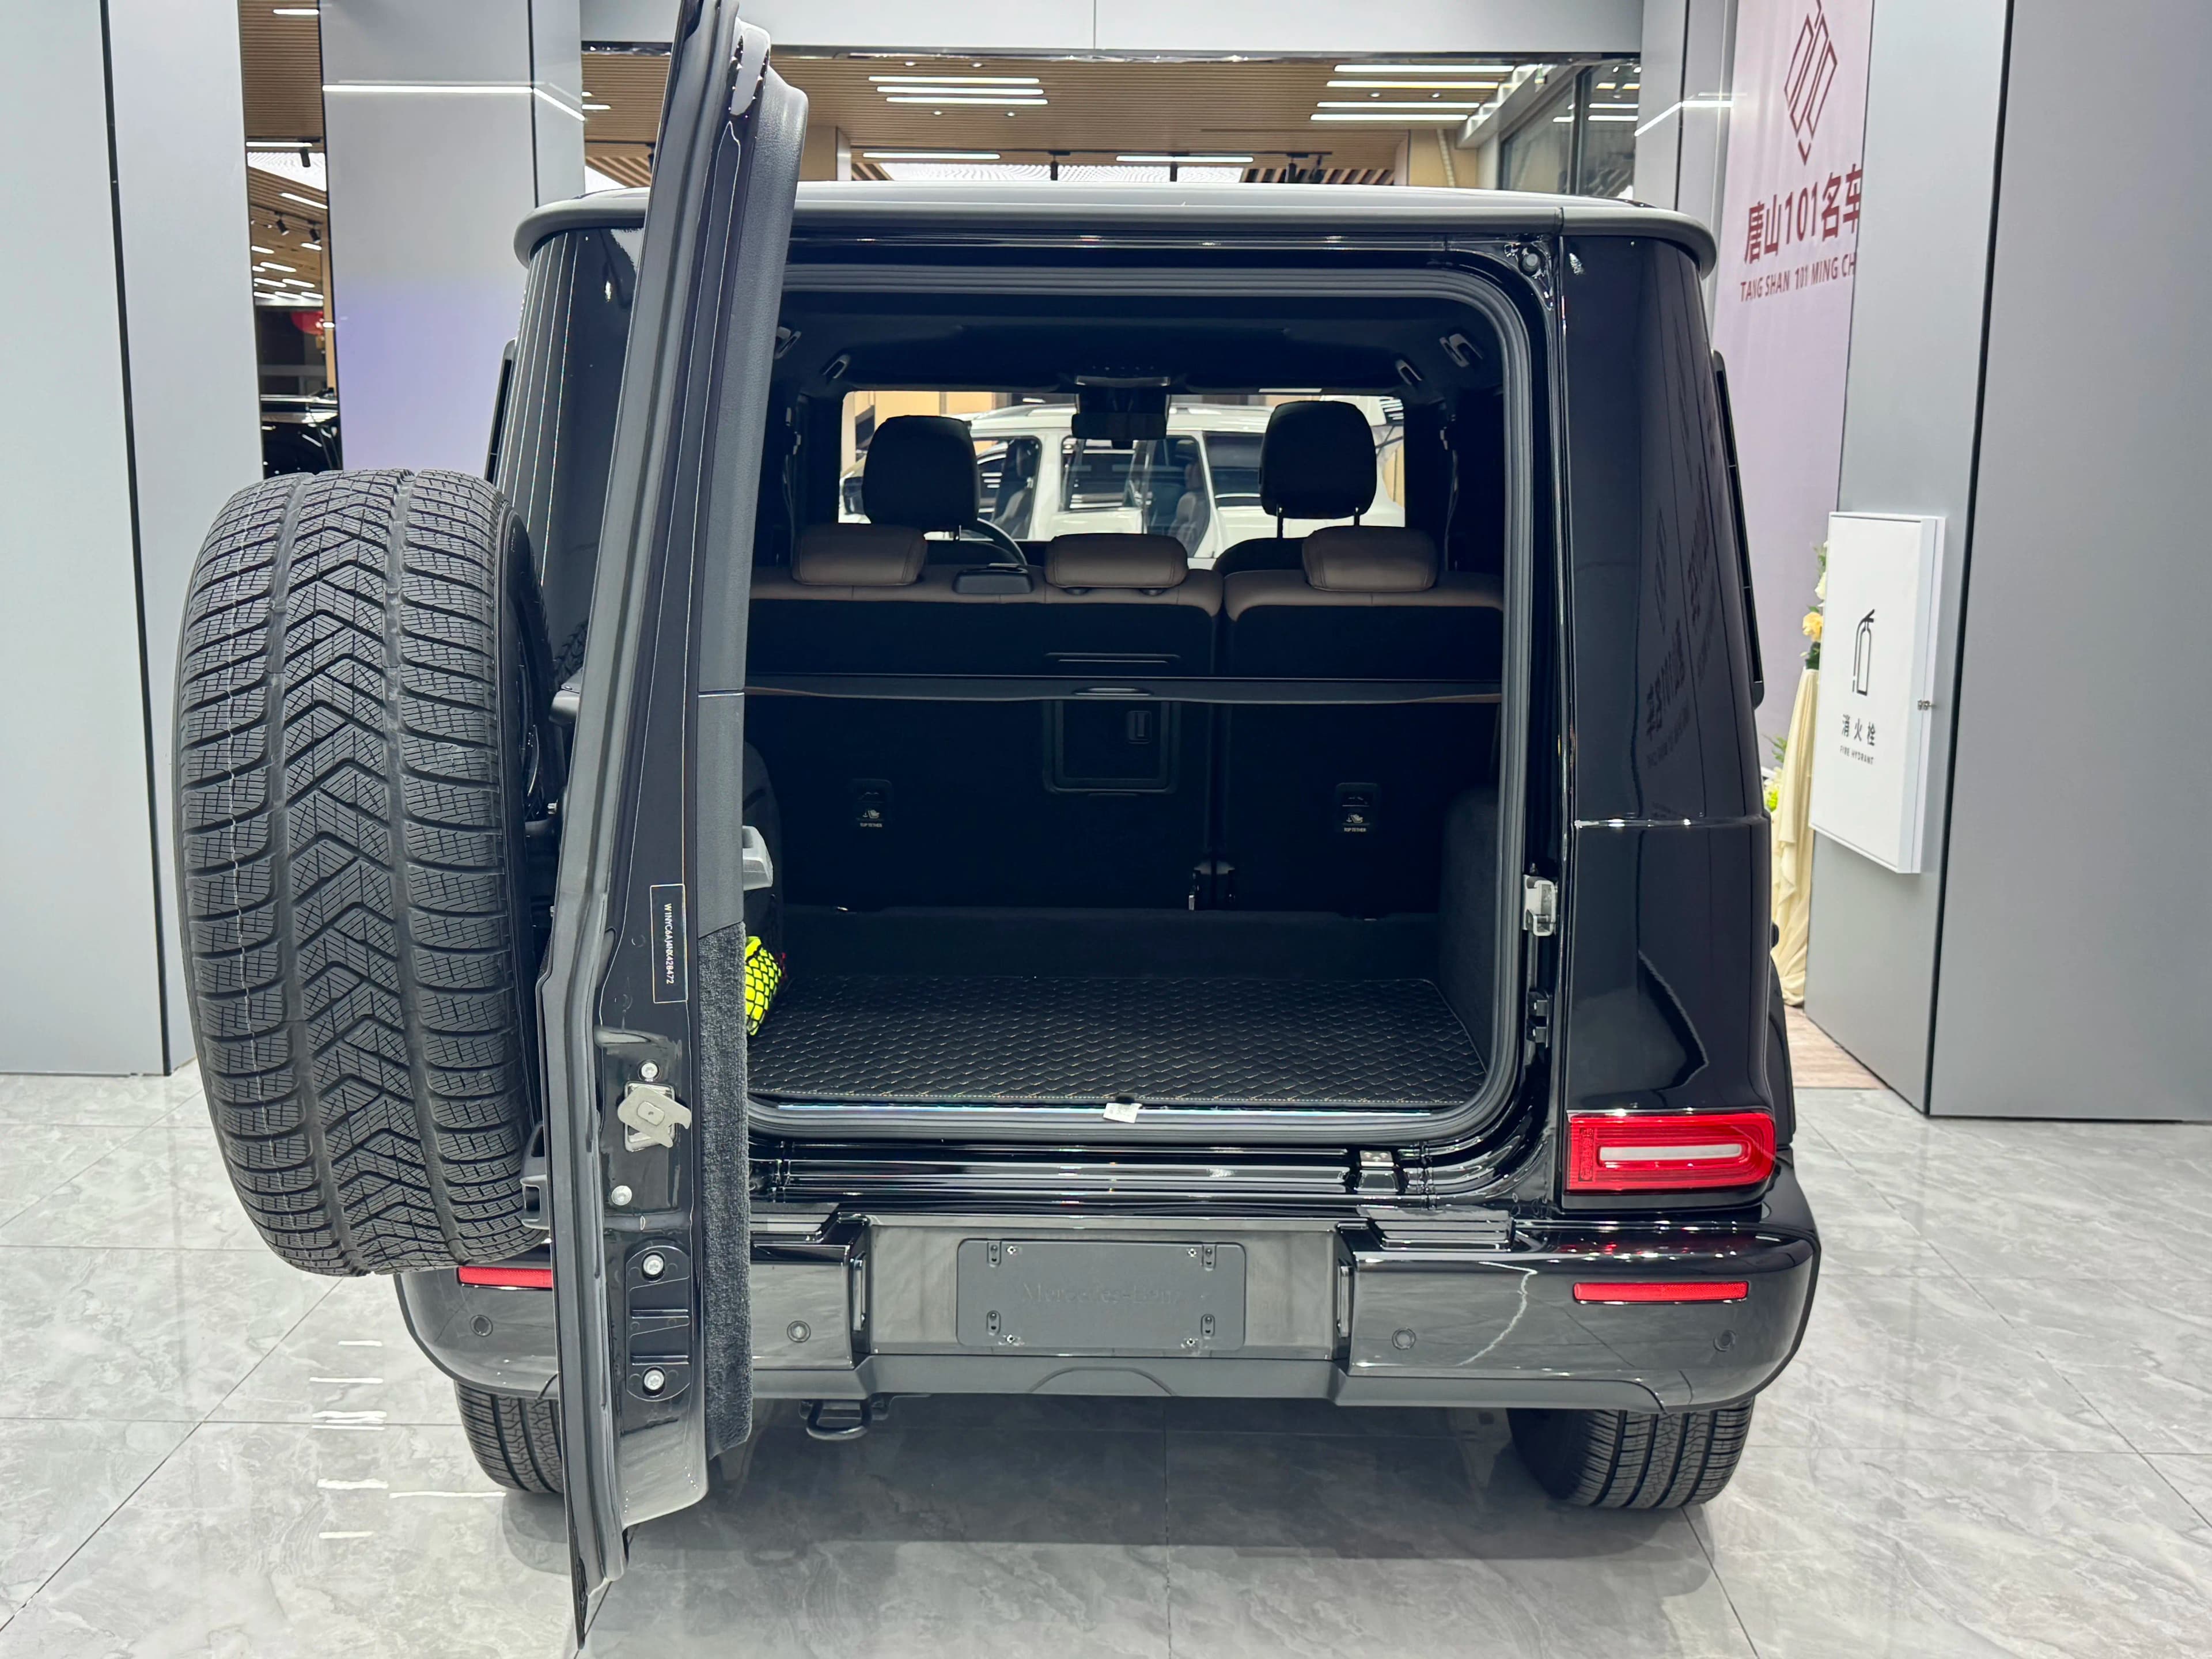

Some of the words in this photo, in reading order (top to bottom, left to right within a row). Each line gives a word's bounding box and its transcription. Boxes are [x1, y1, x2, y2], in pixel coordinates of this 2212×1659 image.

[1745, 164, 1862, 264] 唐山101名车
[1740, 278, 1763, 302] TANG
[1765, 270, 1790, 297] SHAN
[1795, 265, 1809, 290] 101
[1811, 256, 1839, 285] MING
[1842, 714, 1876, 746] 消火栓
[1839, 745, 1850, 757] FIRE
[1851, 750, 1874, 765] HYDRANT
